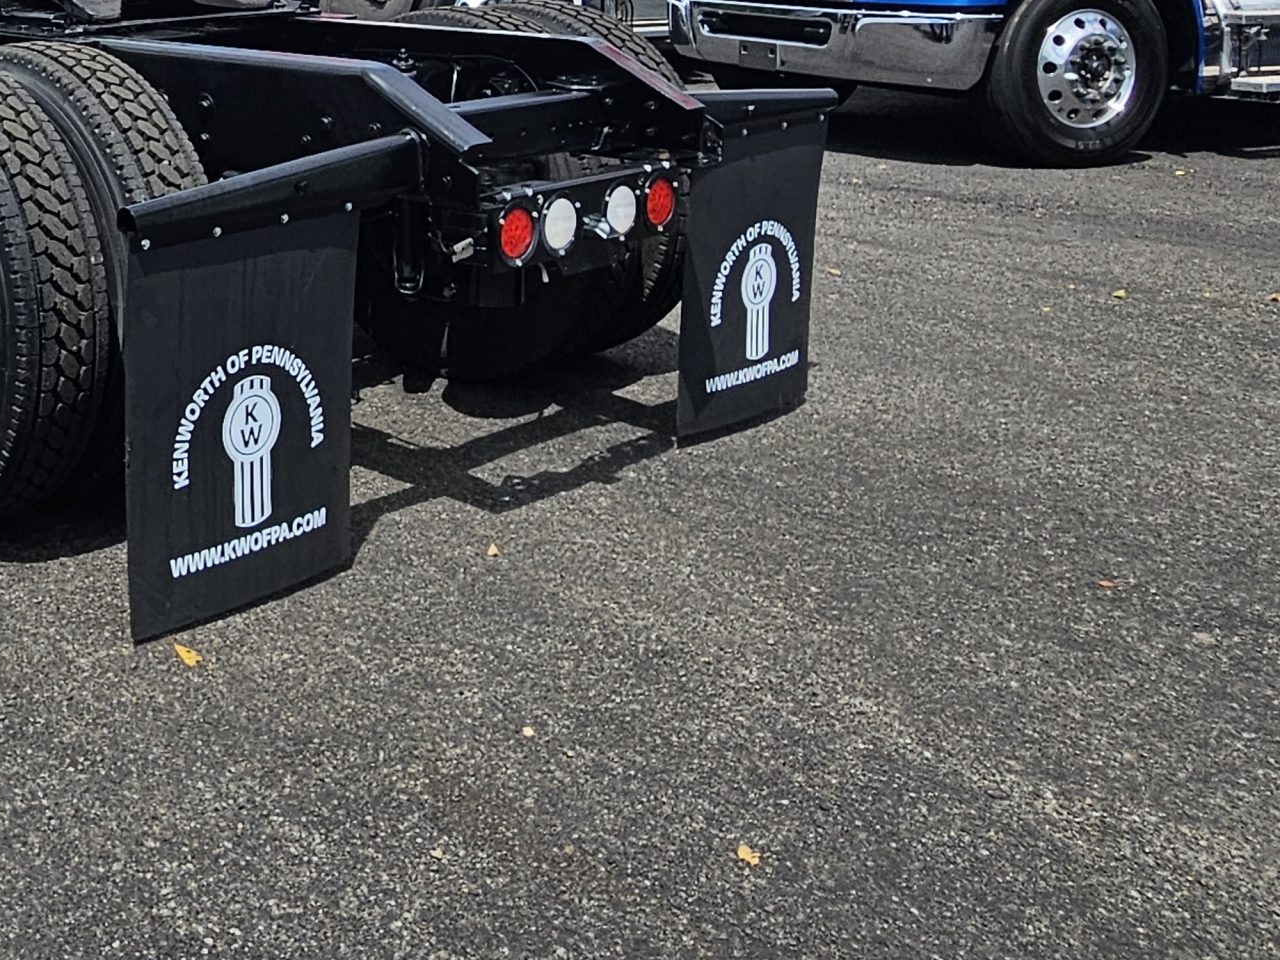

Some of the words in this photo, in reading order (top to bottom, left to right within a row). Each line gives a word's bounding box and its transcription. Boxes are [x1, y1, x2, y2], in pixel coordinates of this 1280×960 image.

[710, 234, 747, 327] KENWORTH
[746, 223, 761, 241] OF
[761, 220, 800, 302] PENNSYLVANIA
[705, 349, 799, 393] WWW.KWOFPA.COM
[172, 365, 227, 490] KENWORTH
[226, 349, 249, 374] OF
[251, 344, 324, 448] PENNSYLVANIA
[170, 507, 327, 578] WWW.KWOFPA.COM
